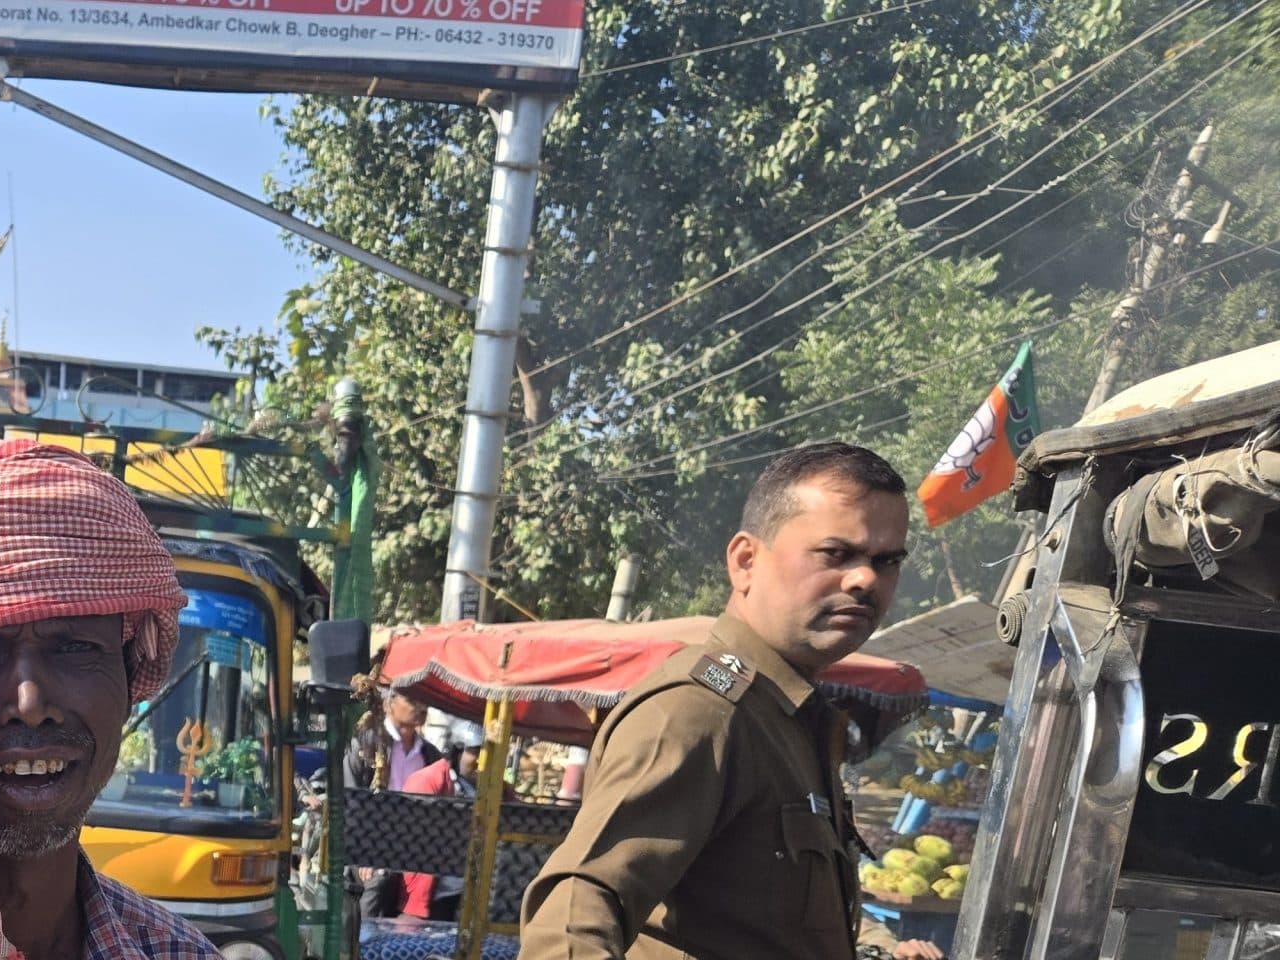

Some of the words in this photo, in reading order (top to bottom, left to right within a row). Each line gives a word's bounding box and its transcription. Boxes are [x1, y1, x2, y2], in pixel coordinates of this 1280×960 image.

[380, 0, 412, 15] TO
[421, 0, 453, 17] 70
[488, 0, 541, 22] OFF
[36, 6, 63, 22] No.
[70, 8, 134, 28] 13/3634,
[137, 12, 221, 32] Ambedkar
[225, 16, 281, 35] Chowk
[307, 22, 375, 42] Deogher
[434, 27, 483, 45] 06432
[497, 31, 555, 50] 319370
